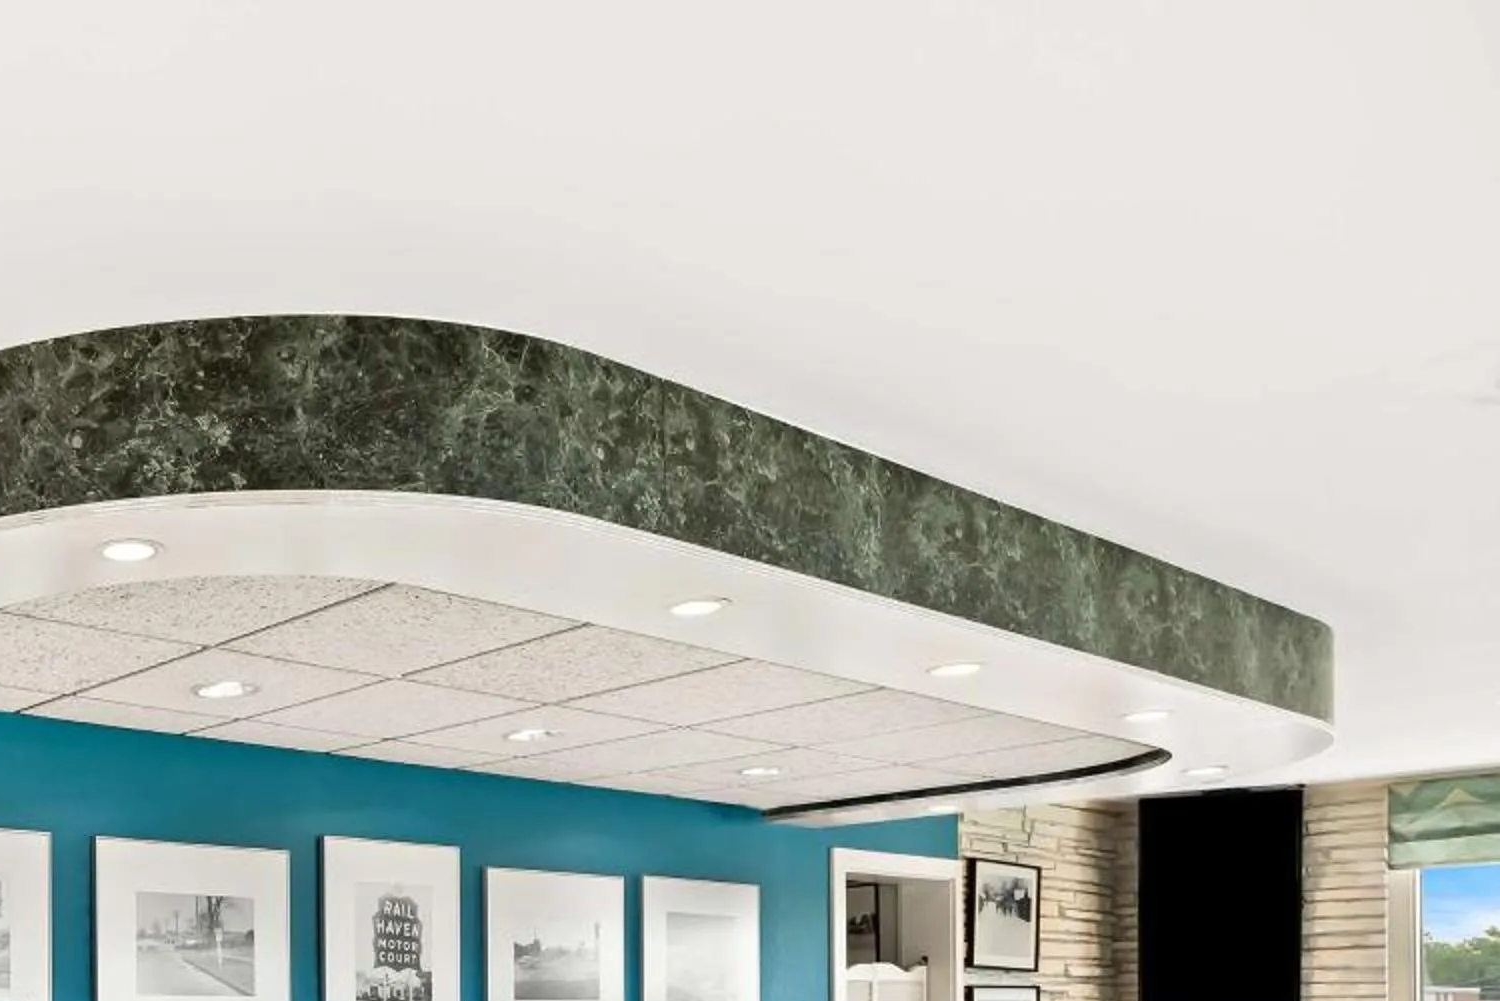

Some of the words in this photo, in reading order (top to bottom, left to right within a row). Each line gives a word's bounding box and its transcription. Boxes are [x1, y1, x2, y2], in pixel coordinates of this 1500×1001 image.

[384, 900, 415, 919] RAIL
[376, 918, 419, 937] HAVEN
[378, 938, 418, 951] MOTOR
[379, 951, 417, 964] COURT
